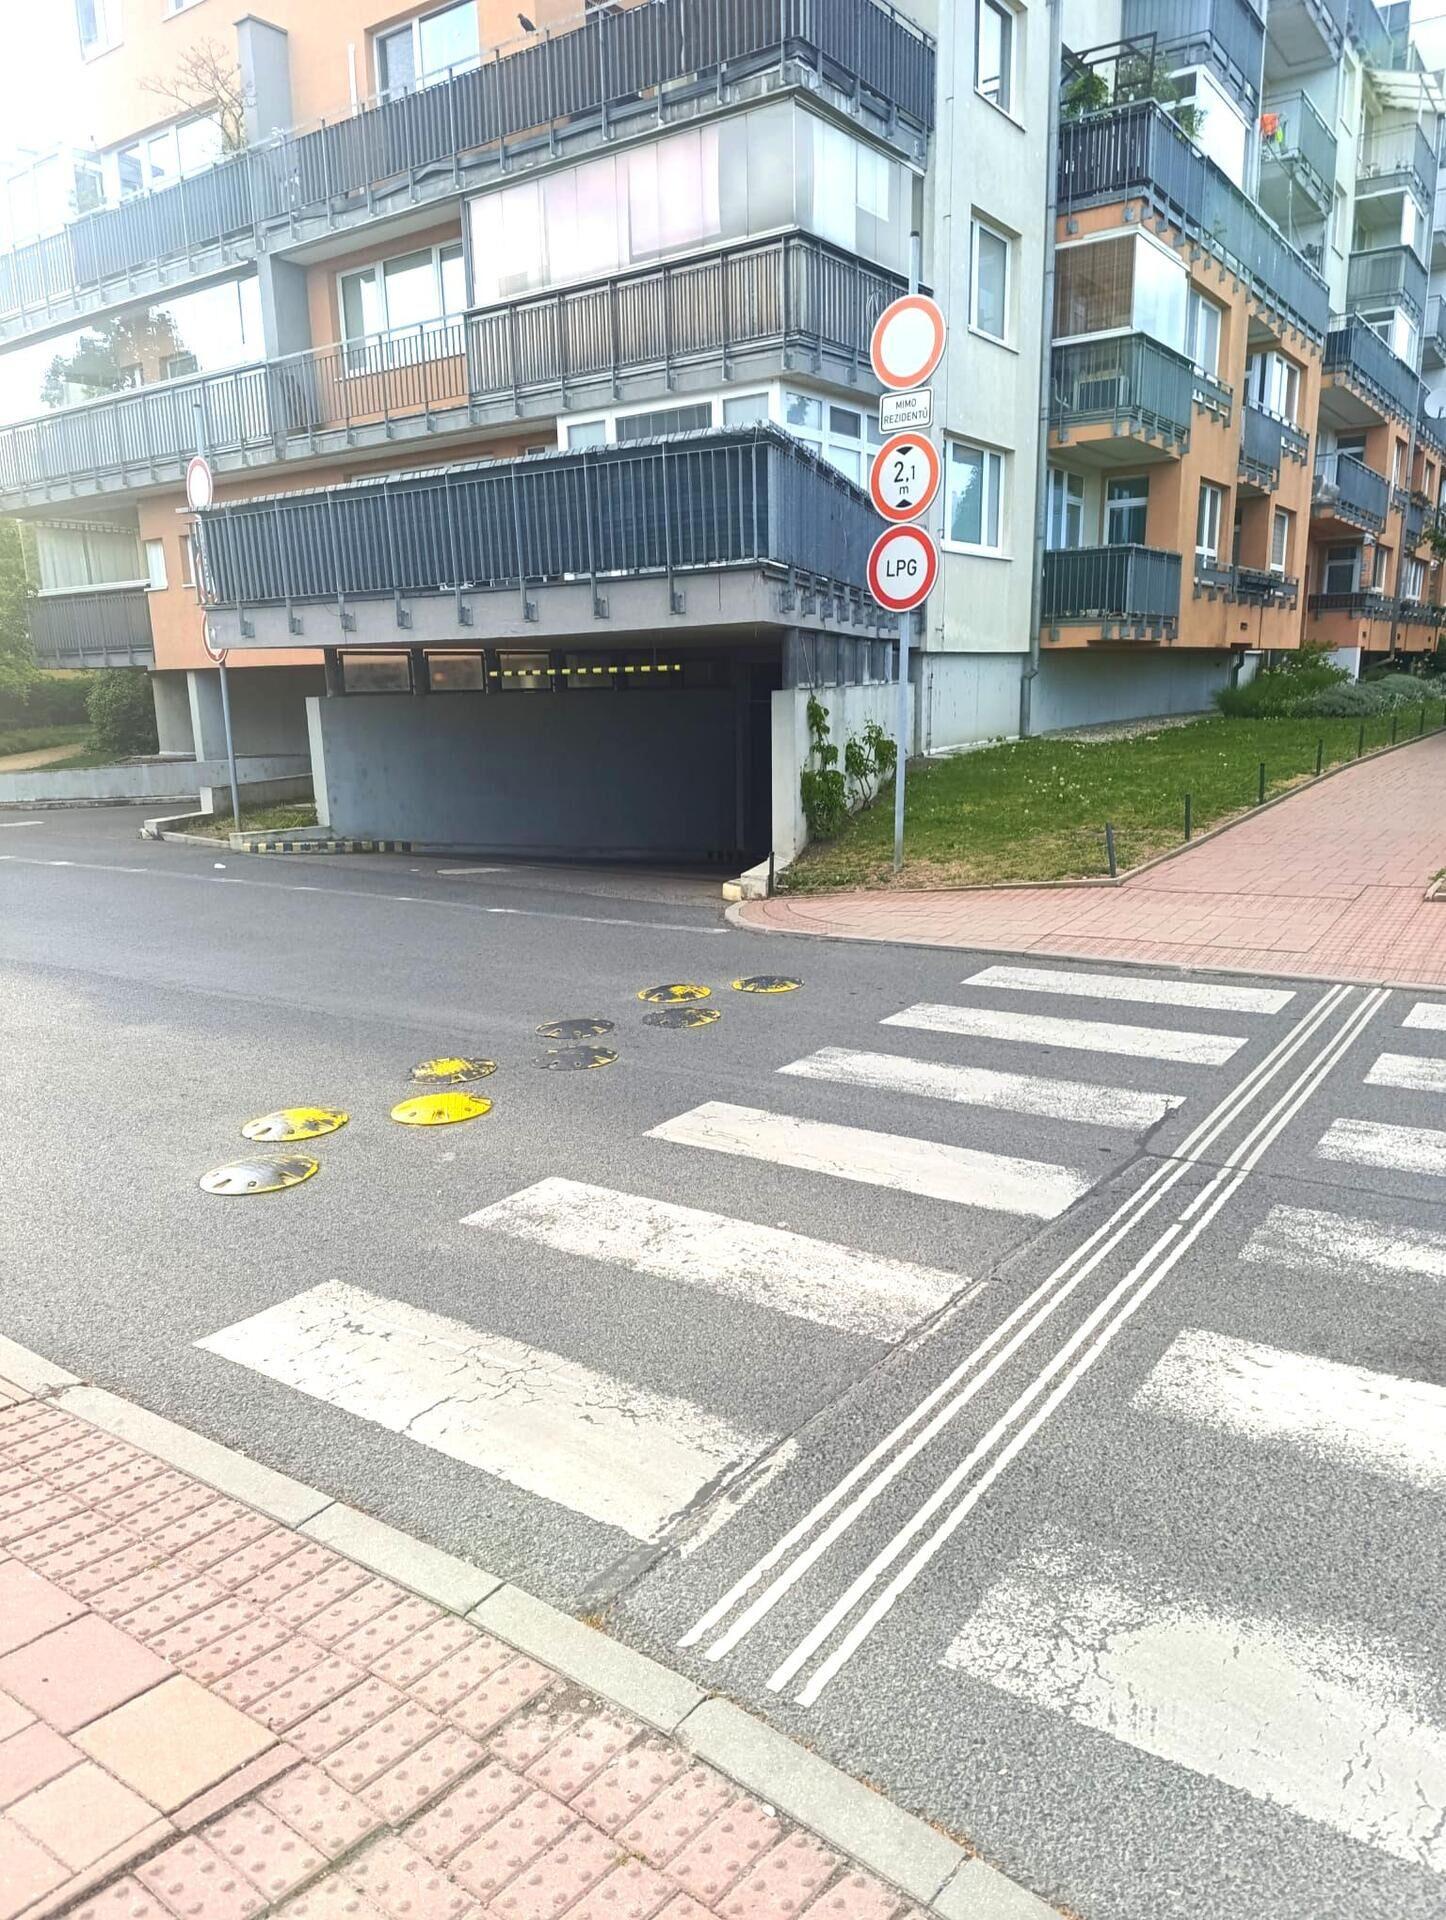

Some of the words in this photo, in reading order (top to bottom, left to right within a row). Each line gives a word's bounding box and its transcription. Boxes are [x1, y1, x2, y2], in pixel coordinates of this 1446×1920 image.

[895, 398, 917, 410] MIMO
[883, 406, 928, 424] REZIDENTŮ
[893, 460, 916, 483] 2,1
[899, 485, 909, 495] m
[886, 558, 917, 577] LPG
